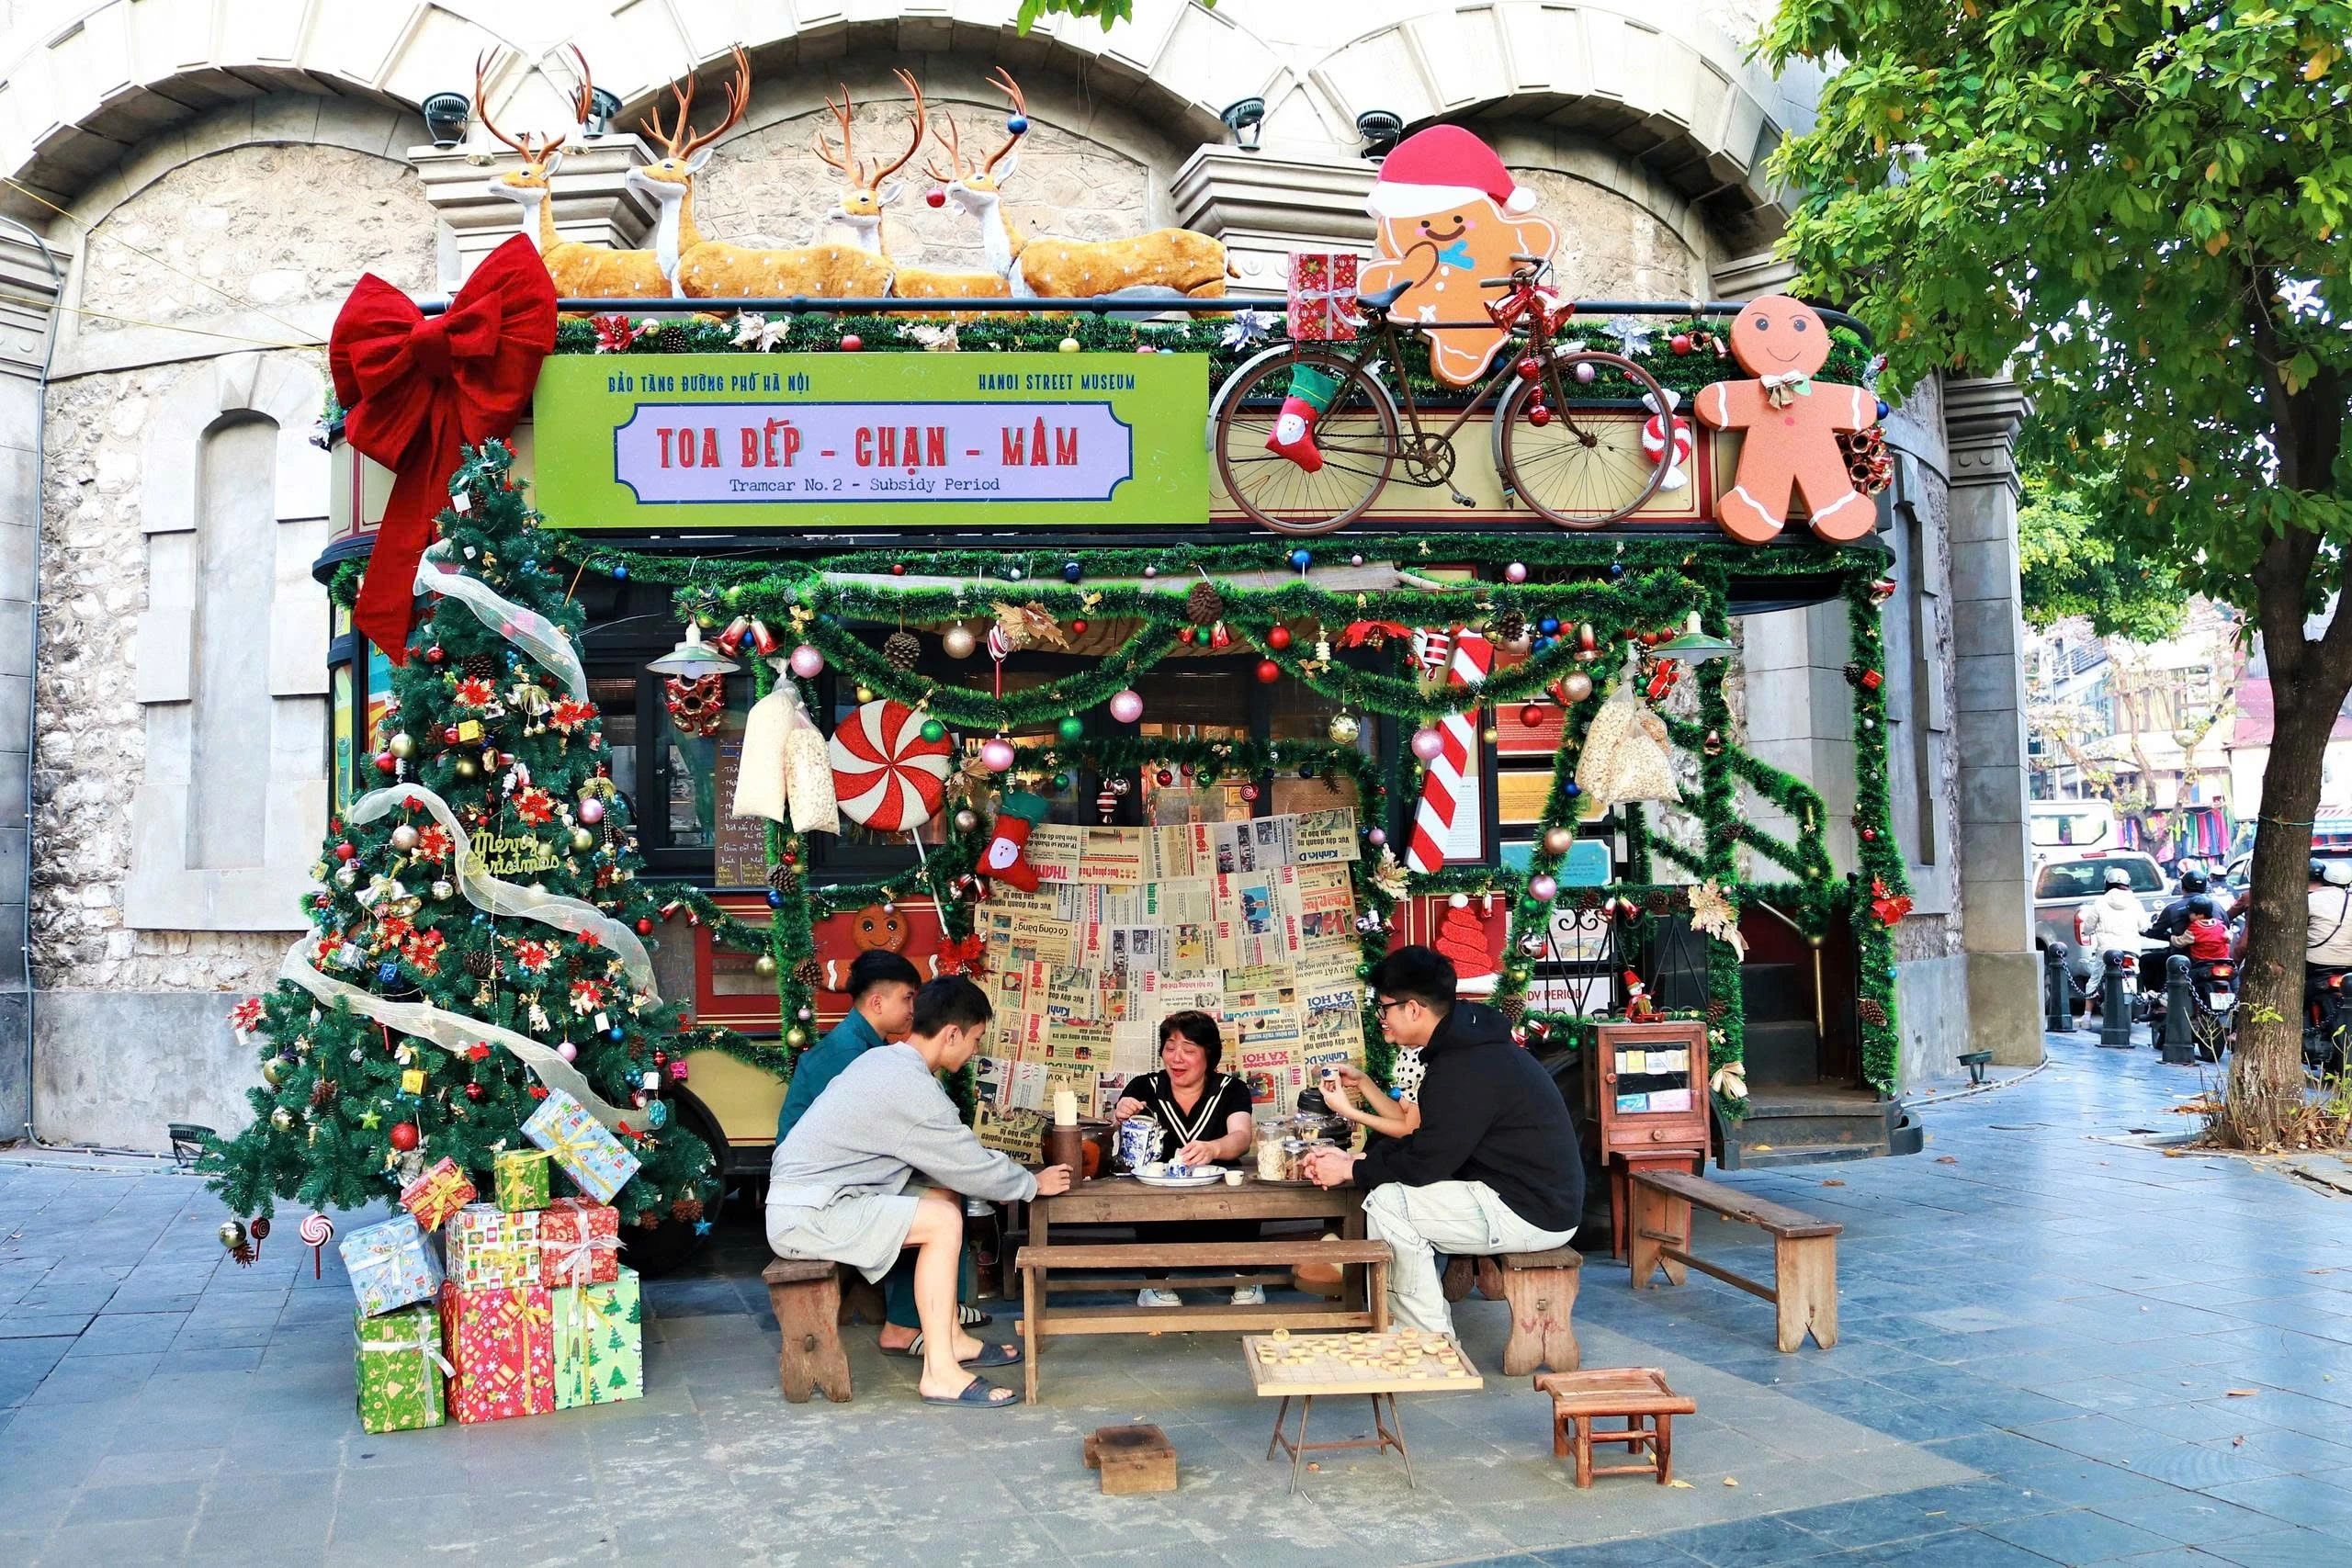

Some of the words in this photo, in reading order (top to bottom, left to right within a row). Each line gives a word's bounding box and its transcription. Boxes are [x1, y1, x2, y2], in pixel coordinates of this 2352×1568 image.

[608, 371, 634, 392] BẢO
[641, 373, 674, 392] TÀNG
[681, 373, 724, 391] ĐƯỜNG
[731, 372, 760, 391] PHỐ
[763, 373, 780, 391] HÀ
[788, 372, 810, 394] NỘI
[978, 374, 1019, 389] HANOI
[1026, 374, 1073, 389] STREET
[1080, 374, 1135, 389] MUSEUM
[656, 427, 721, 468] TOA
[741, 417, 801, 468] BẾP
[855, 426, 947, 476] CHẠN
[1001, 416, 1079, 467] MÂM
[729, 479, 796, 492] Tramcar
[870, 478, 935, 493] Subsidy
[944, 478, 1001, 491] Period
[469, 828, 537, 857] Merry
[1544, 989, 1583, 1000] PERIOD
